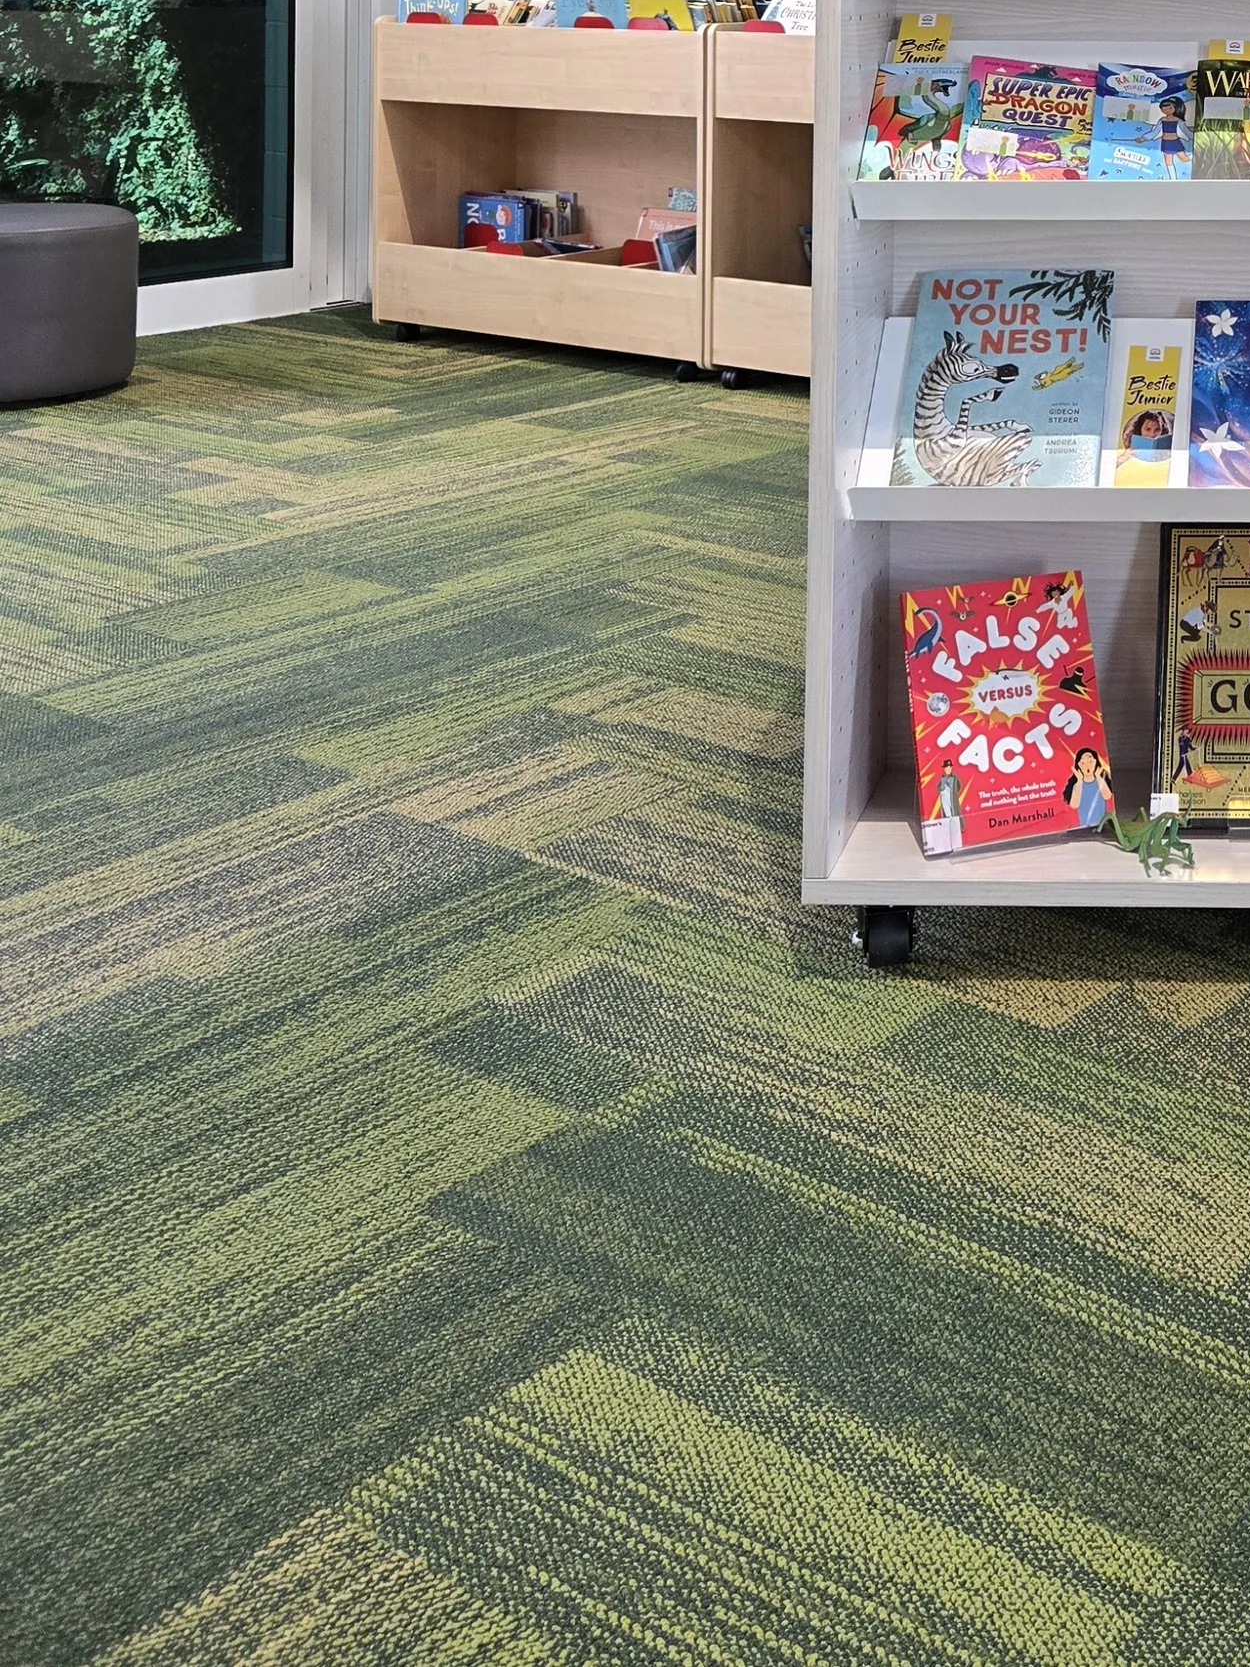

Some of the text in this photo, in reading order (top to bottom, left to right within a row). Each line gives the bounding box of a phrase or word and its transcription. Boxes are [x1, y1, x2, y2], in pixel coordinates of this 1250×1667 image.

[898, 37, 946, 53] Bestie
[896, 50, 943, 64] Junior
[988, 77, 1093, 102] SUPER EPIC
[983, 92, 1088, 116] DRAGON
[1002, 108, 1073, 128] QUEST
[931, 278, 1004, 301] NOT
[949, 303, 1041, 326] YOUR
[979, 328, 1089, 355] NEST!
[1128, 375, 1177, 392] Bestie
[1126, 388, 1174, 406] Junior
[1048, 416, 1079, 424] STERER
[931, 614, 1071, 683] FALSE
[977, 685, 1033, 703] VERSUS
[936, 702, 1083, 774] FACTS
[978, 779, 1057, 799] The truth, the whole truth
[980, 799, 993, 808] and
[993, 796, 1018, 805] nothing
[1028, 792, 1040, 800] the
[1040, 788, 1057, 798] truth
[988, 807, 1055, 829] Dan Marshall
